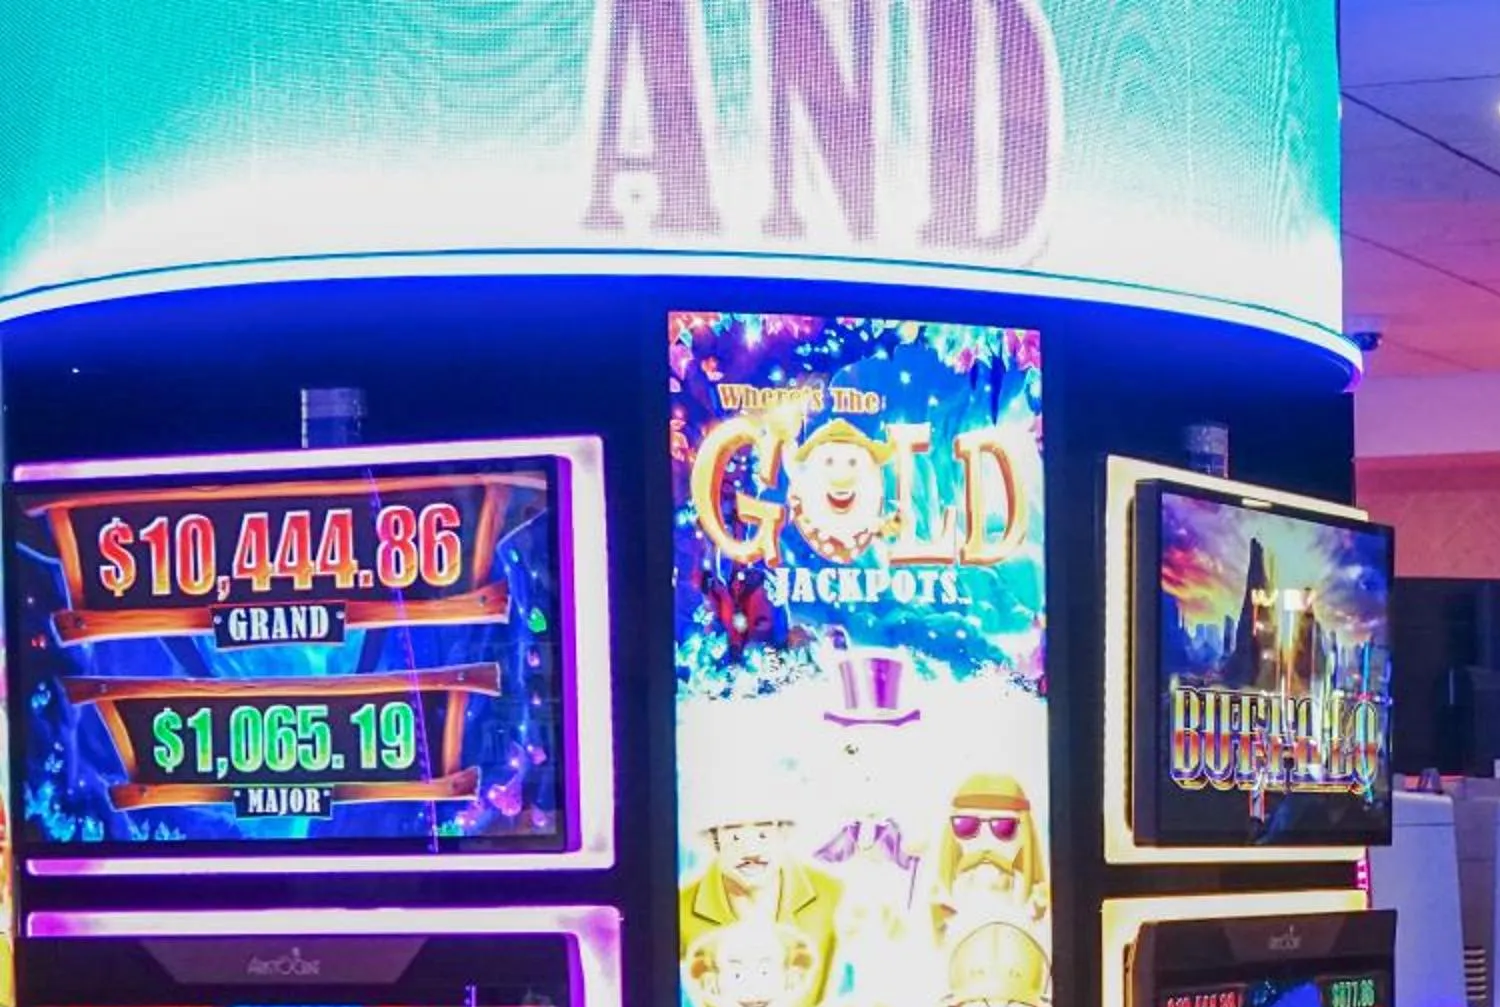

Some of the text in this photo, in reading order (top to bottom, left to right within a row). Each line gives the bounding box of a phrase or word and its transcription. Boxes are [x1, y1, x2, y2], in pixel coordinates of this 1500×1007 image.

[582, 0, 1059, 253] AND
[99, 503, 462, 602] $10,444.86
[767, 567, 959, 605] JACKPOTS
[228, 604, 331, 642] GRAND
[152, 702, 418, 779] $1,065.19
[246, 787, 322, 816] MAJOR
